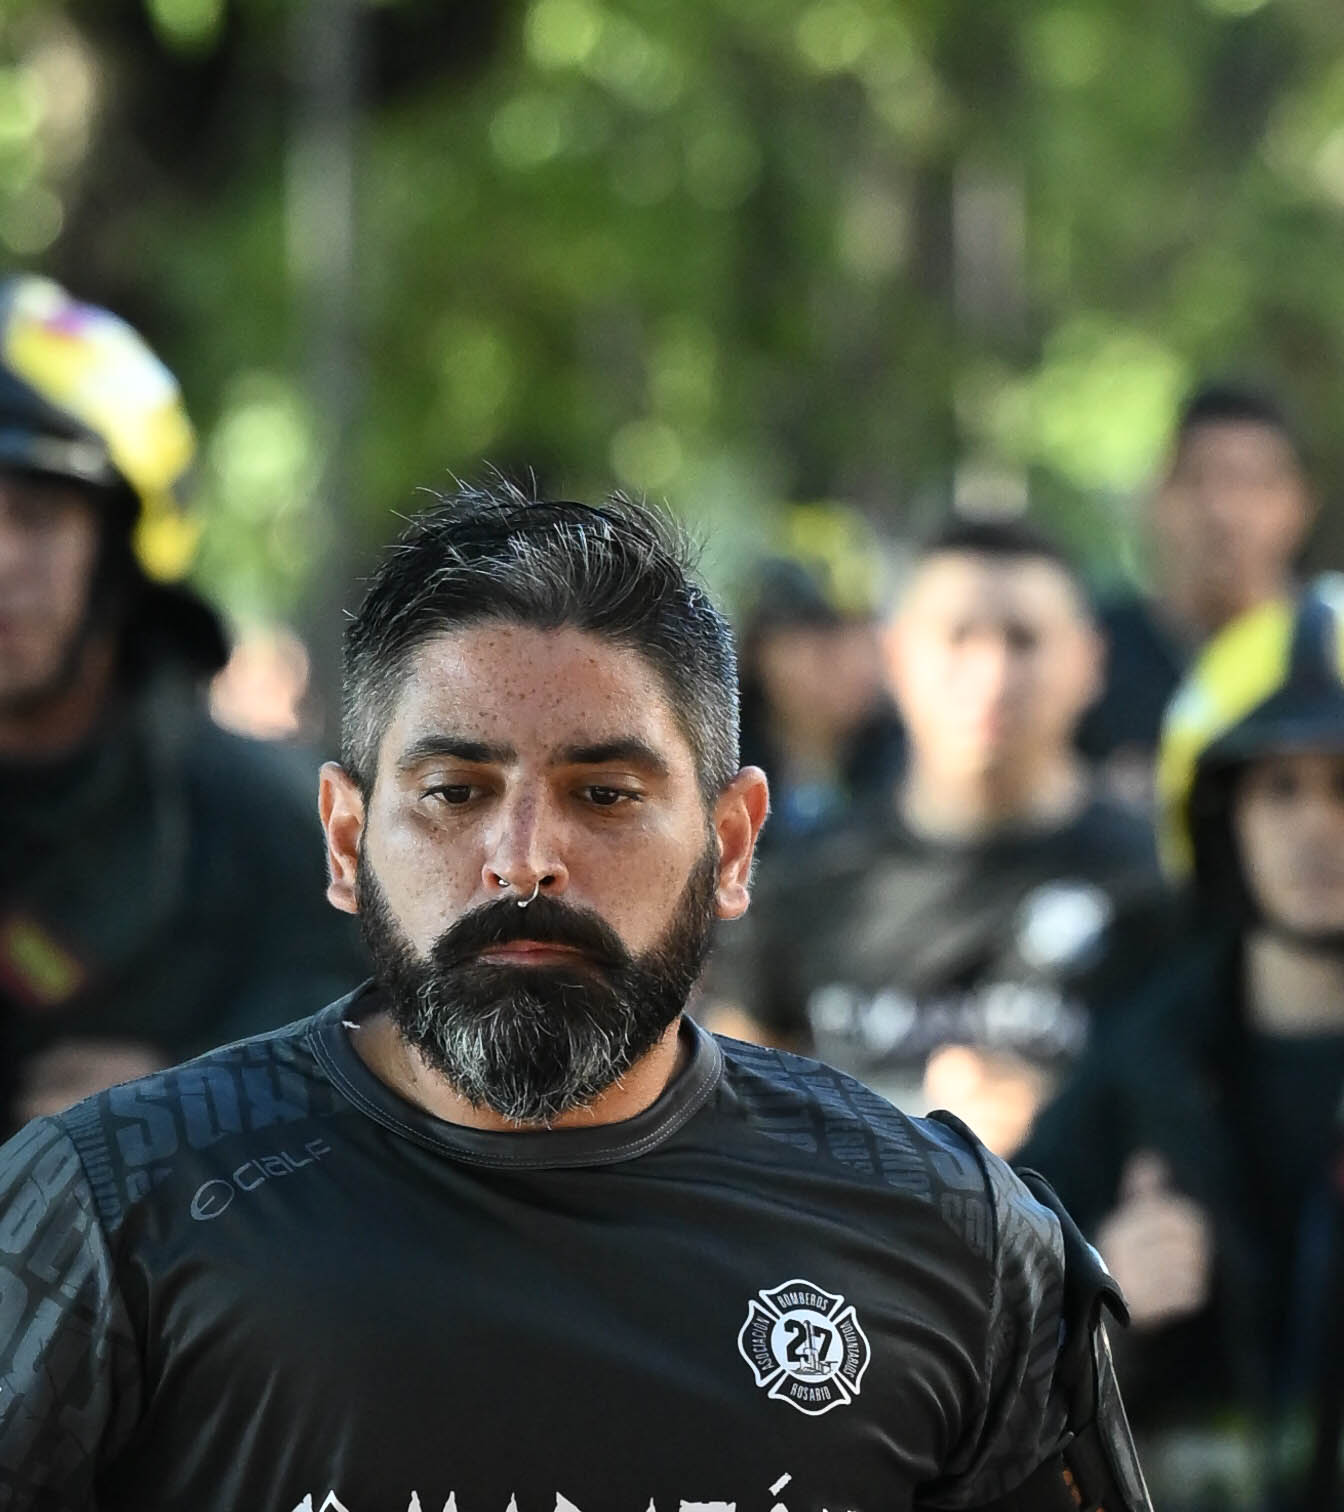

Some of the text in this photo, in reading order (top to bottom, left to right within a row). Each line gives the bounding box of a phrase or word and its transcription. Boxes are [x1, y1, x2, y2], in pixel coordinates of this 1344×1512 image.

[777, 1292, 829, 1311] BOMBEROS
[784, 1319, 833, 1363] 27
[790, 1383, 831, 1401] ROSARIO
